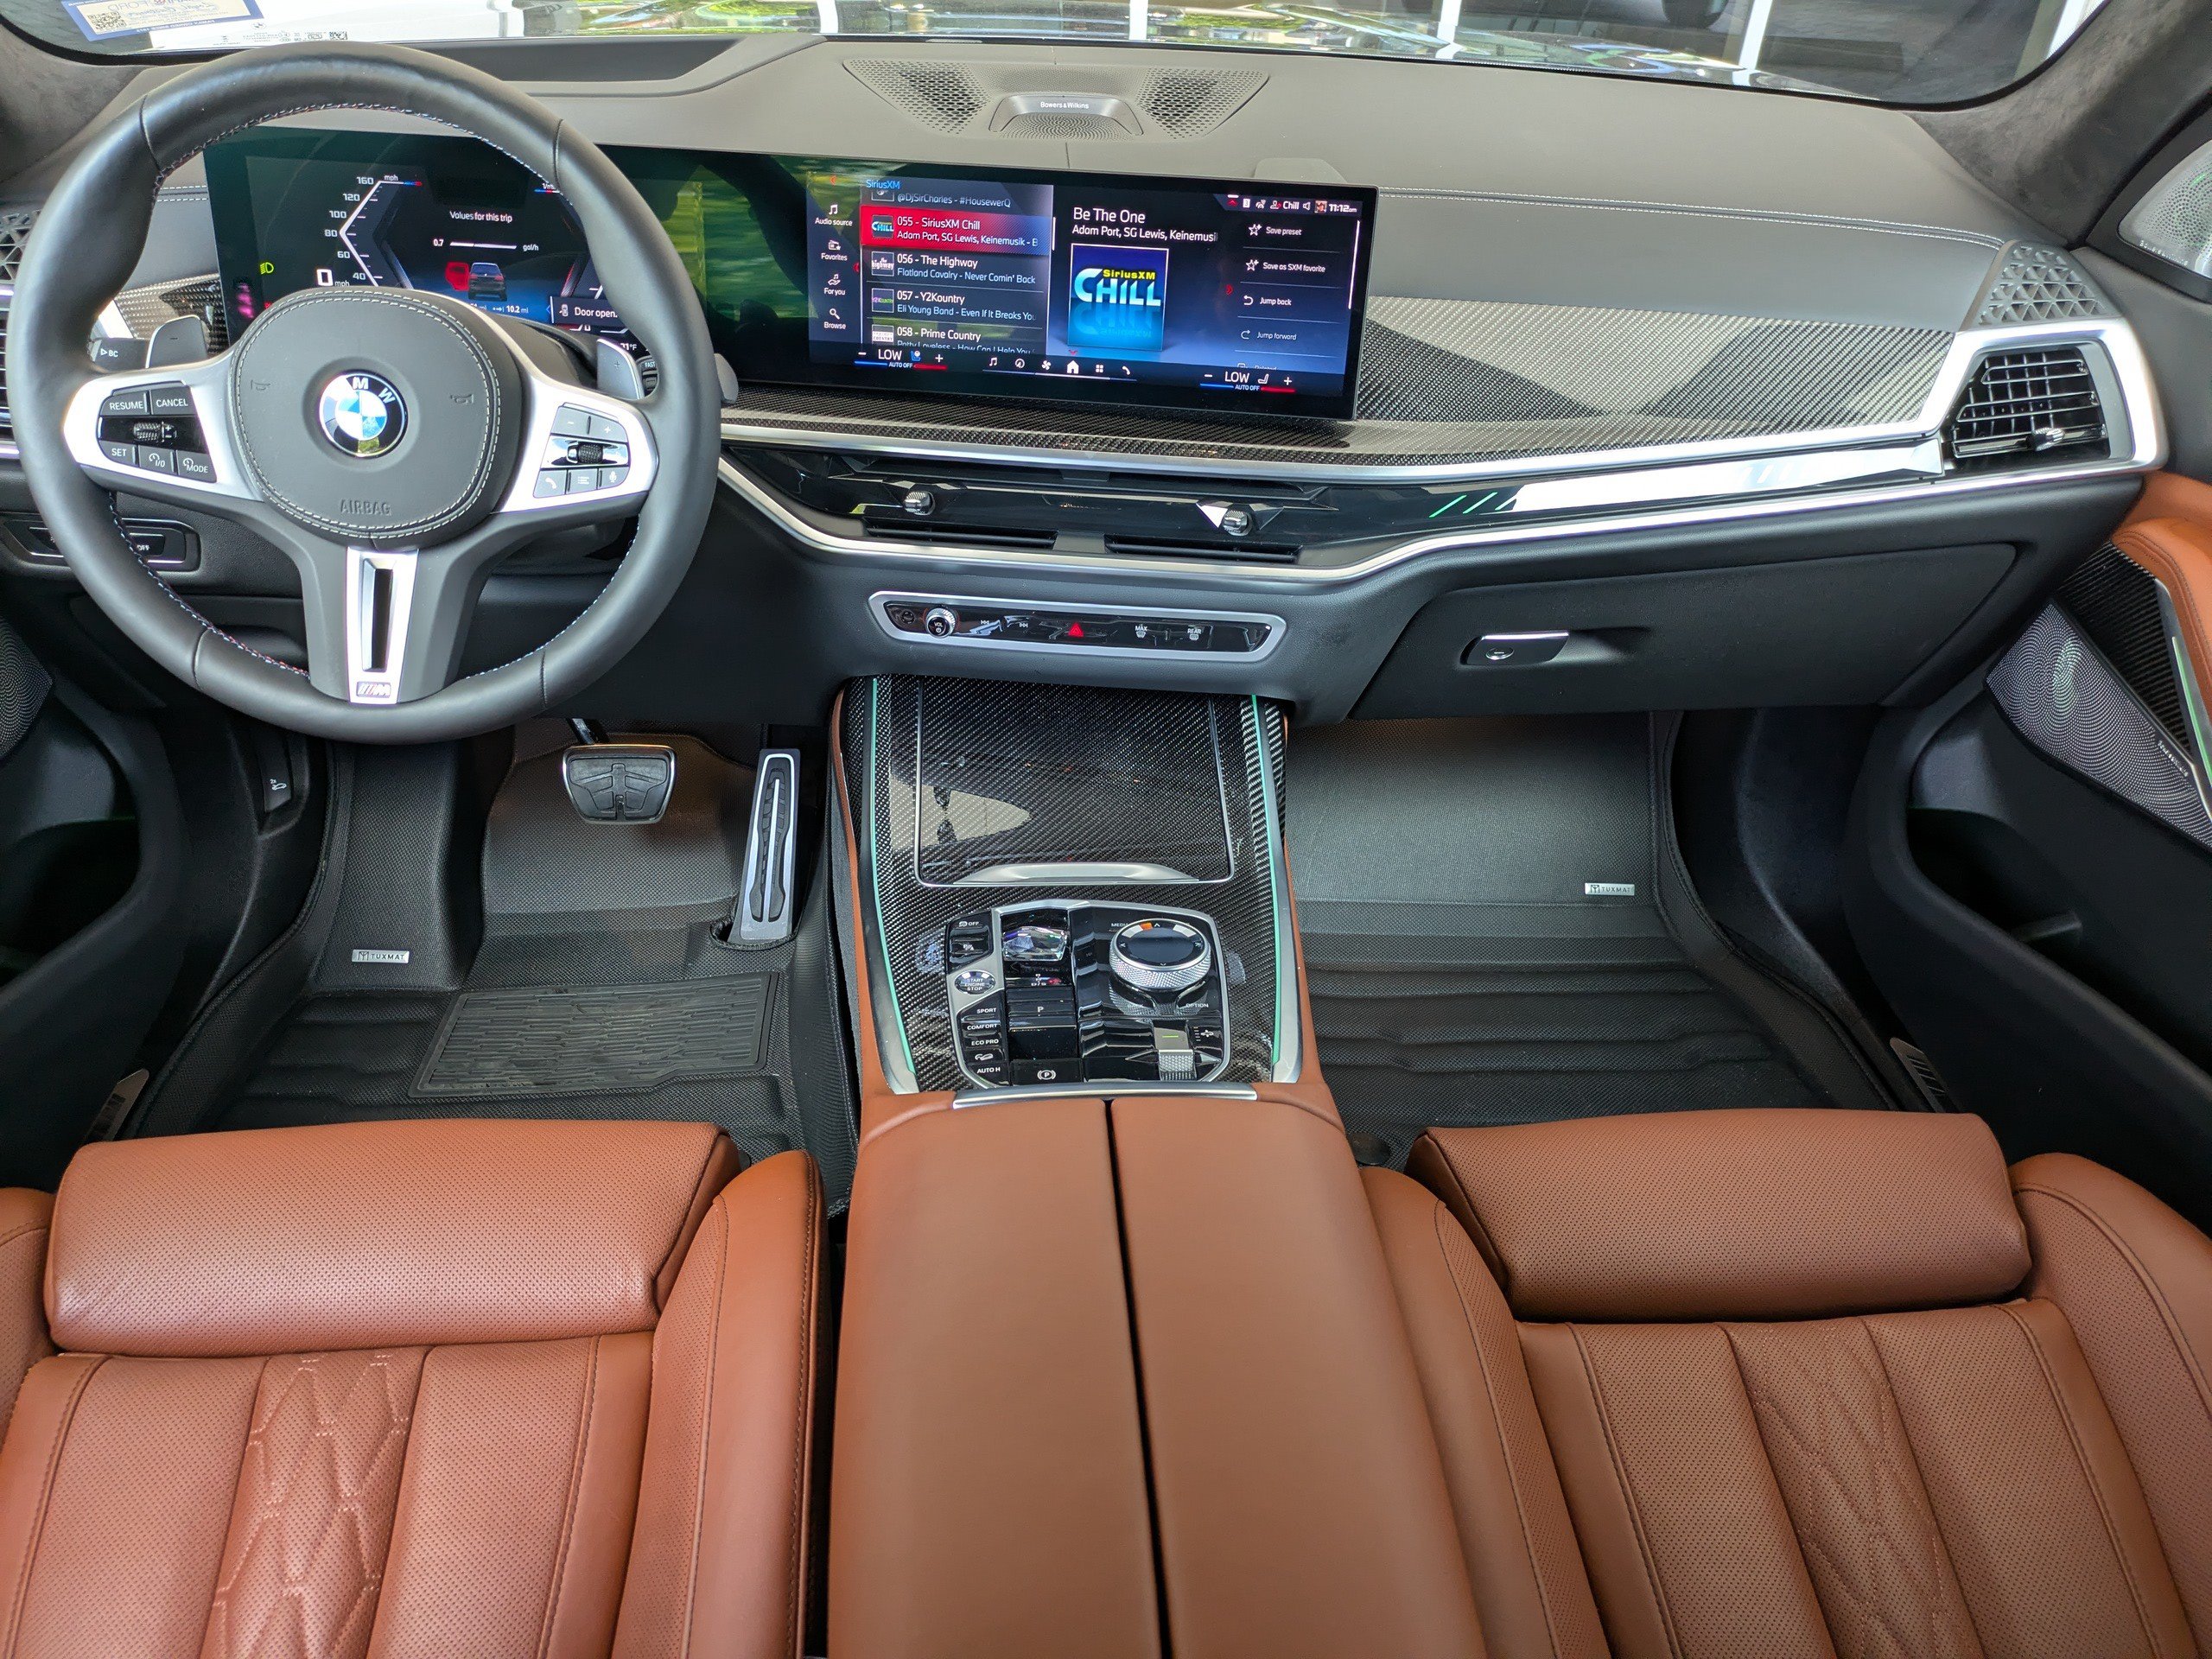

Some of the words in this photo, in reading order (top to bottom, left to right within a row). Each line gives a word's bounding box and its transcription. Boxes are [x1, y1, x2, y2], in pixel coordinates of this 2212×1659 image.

[356, 176, 374, 185] 160
[867, 180, 900, 189] SiriusXM
[1283, 201, 1300, 210] Chill
[329, 210, 346, 219] 100
[450, 211, 474, 220] Values
[474, 212, 485, 220] for
[486, 213, 499, 221] this
[500, 213, 513, 224] trip
[1073, 207, 1090, 220] Be
[1093, 207, 1116, 222] The
[1120, 210, 1146, 224] One
[898, 216, 912, 226] 055
[922, 218, 960, 229] SiriusXM
[962, 220, 980, 230] Chill
[324, 229, 338, 238] 80
[897, 231, 920, 239] Adam
[922, 232, 940, 241] Port,
[955, 234, 979, 244] Lewis,
[982, 236, 1025, 245] Keinemusik
[1071, 224, 1099, 235] Adam
[1102, 226, 1122, 238] Port,
[1123, 227, 1137, 238] SG
[1139, 228, 1167, 240] Lewis,
[523, 244, 539, 252] gal/h
[872, 260, 894, 270] highway
[898, 254, 912, 264] 056
[920, 255, 938, 265] The
[940, 257, 978, 270] Highway
[1303, 264, 1325, 273] favorite
[316, 269, 334, 286] 0
[898, 268, 928, 276] Flatland
[930, 270, 958, 281] Cavalry
[965, 272, 987, 281] Never
[988, 273, 1015, 283] Comin'
[1017, 275, 1035, 284] Back
[1103, 269, 1156, 281] SiriusXM
[1074, 267, 1161, 307] CHILL
[898, 290, 912, 301] 057
[920, 291, 965, 305] Y2Kountry
[1260, 297, 1276, 306] Jump
[505, 305, 520, 314] 10.2
[575, 307, 594, 317] Door
[595, 308, 618, 319] open.
[898, 304, 906, 313] Eli
[908, 305, 931, 316] Young
[933, 306, 954, 315] Band
[961, 308, 980, 317] Even
[982, 308, 988, 318] If
[988, 309, 994, 318] It
[995, 310, 1021, 321] Breaks
[897, 327, 912, 337] 058
[920, 327, 945, 340] Prime
[948, 330, 981, 342] Country
[878, 349, 902, 361] LOW
[1224, 372, 1249, 383] LOW
[109, 400, 143, 410] RESUME
[156, 398, 188, 408] CANCEL
[111, 448, 127, 457] SET
[187, 463, 208, 474] MODE
[340, 499, 391, 516] AIRBAG
